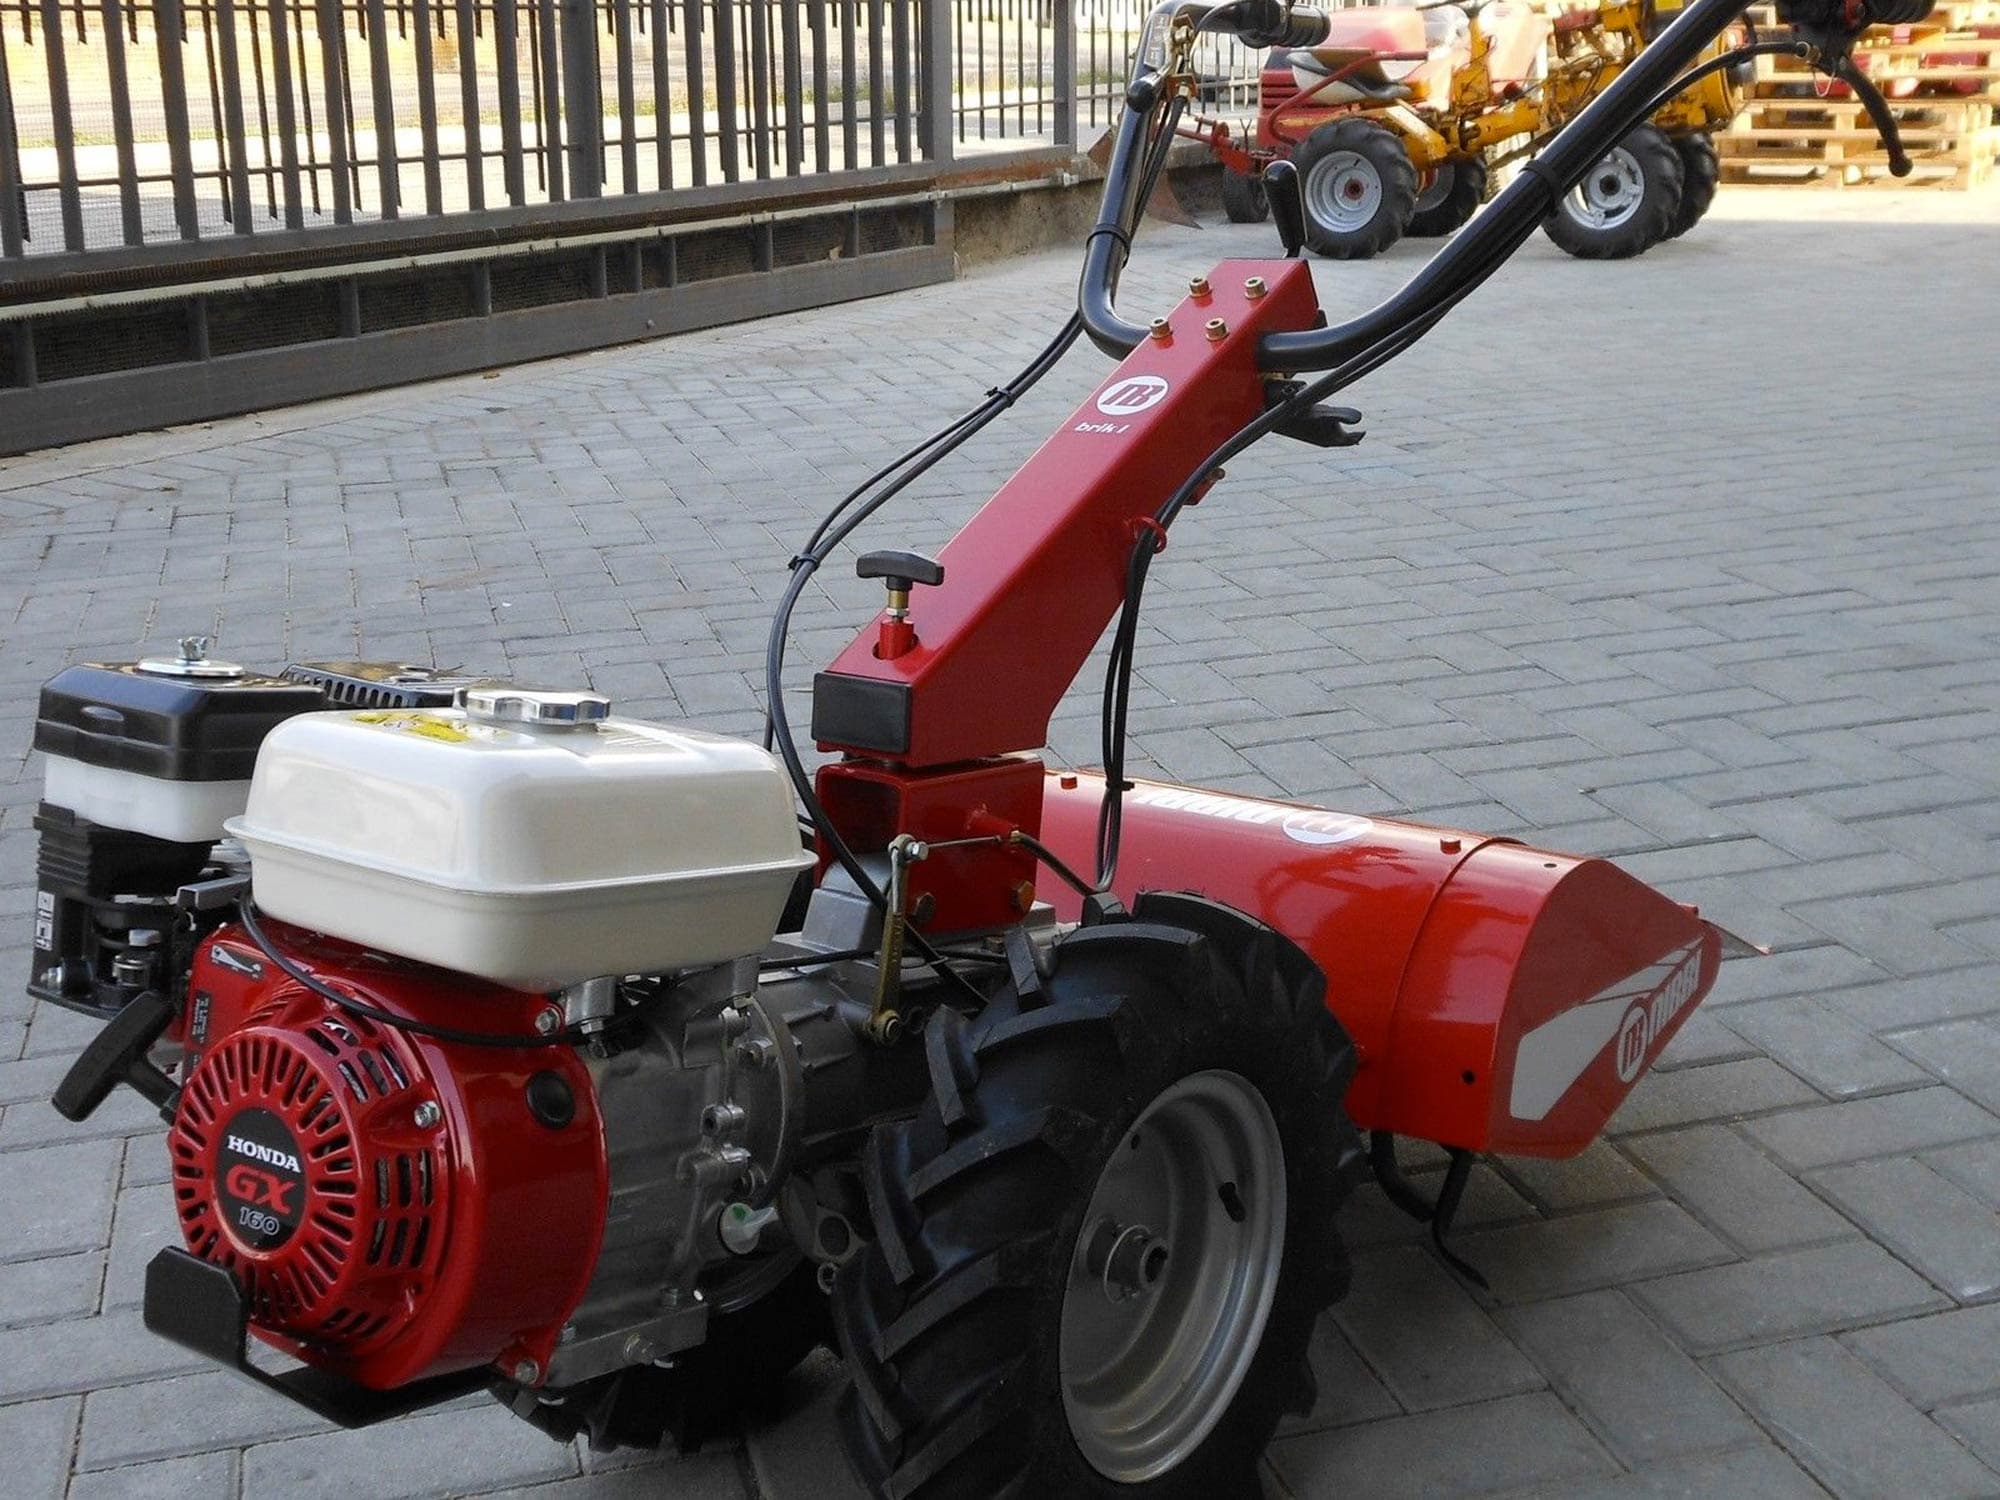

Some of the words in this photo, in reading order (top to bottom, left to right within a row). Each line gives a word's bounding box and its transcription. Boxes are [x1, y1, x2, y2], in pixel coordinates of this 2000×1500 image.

[227, 1135, 301, 1173] HONDA
[227, 1164, 295, 1214] GX
[239, 1207, 280, 1235] 160
